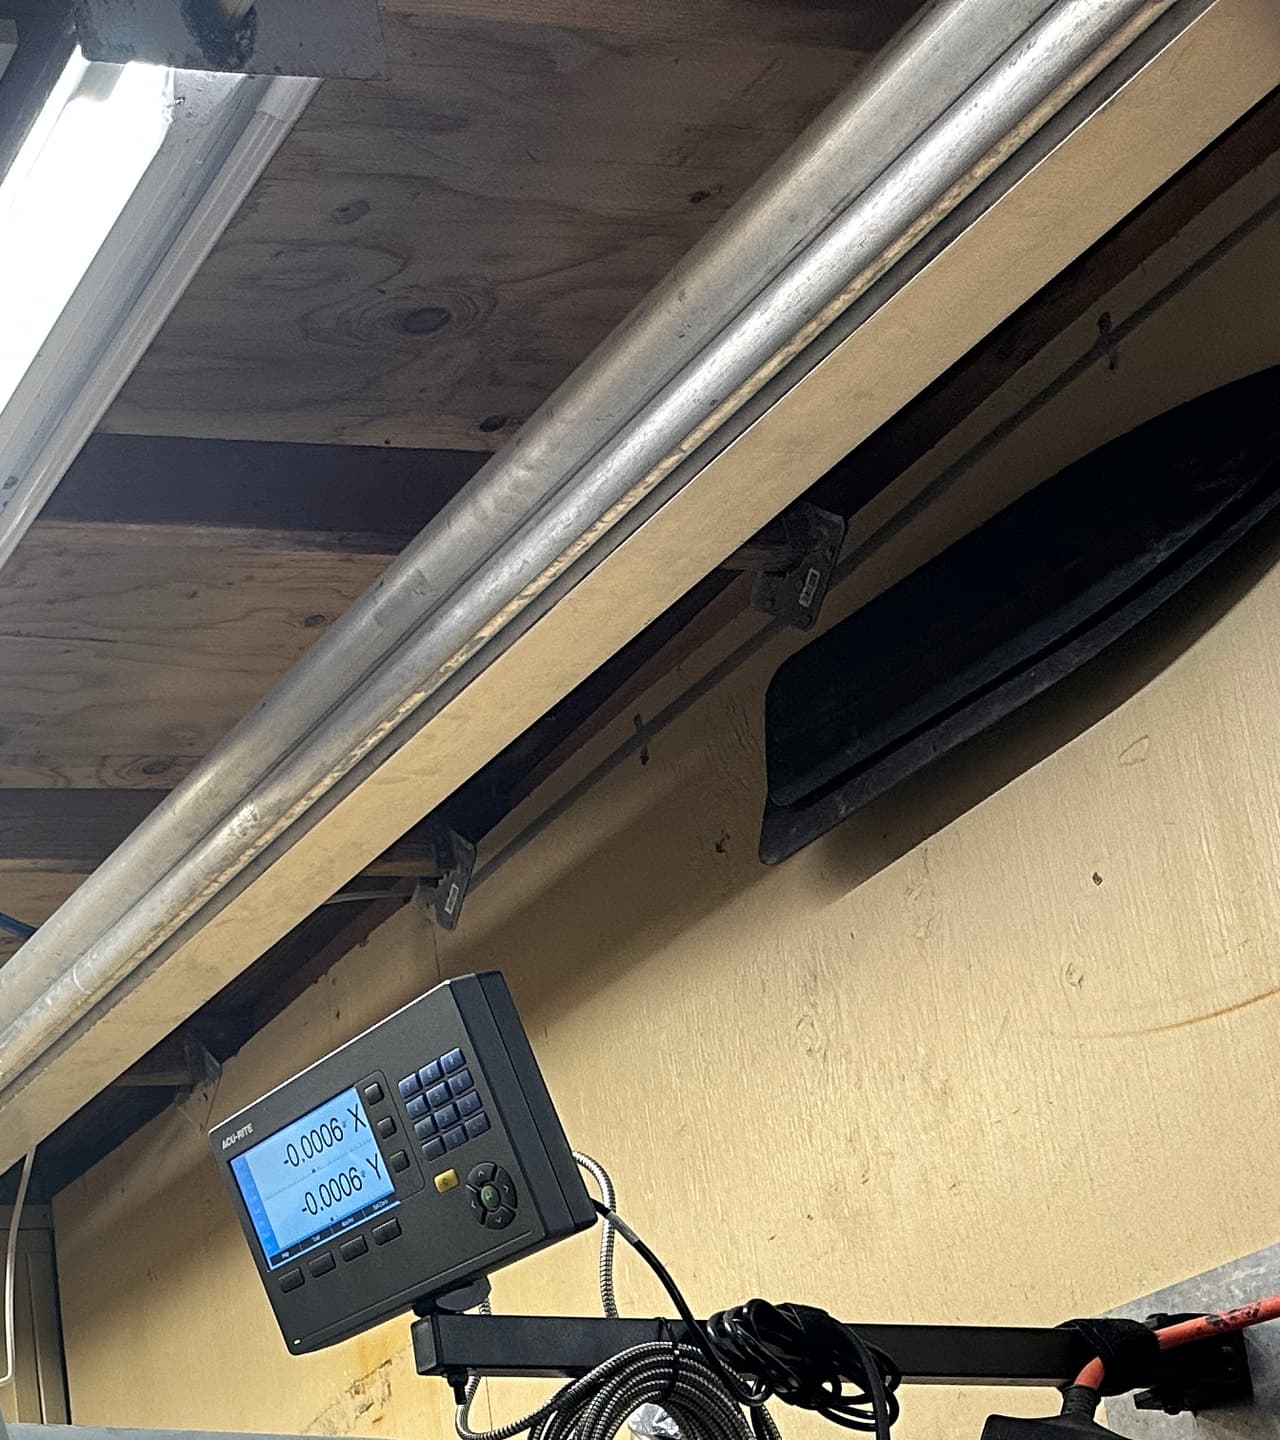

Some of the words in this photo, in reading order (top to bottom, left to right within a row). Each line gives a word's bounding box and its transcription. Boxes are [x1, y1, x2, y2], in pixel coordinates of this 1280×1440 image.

[222, 1122, 254, 1150] ACU-RITE
[283, 1117, 344, 1168] -0.0006
[347, 1103, 366, 1132] X
[302, 1167, 362, 1215] -0.0006
[365, 1153, 382, 1180] Y
